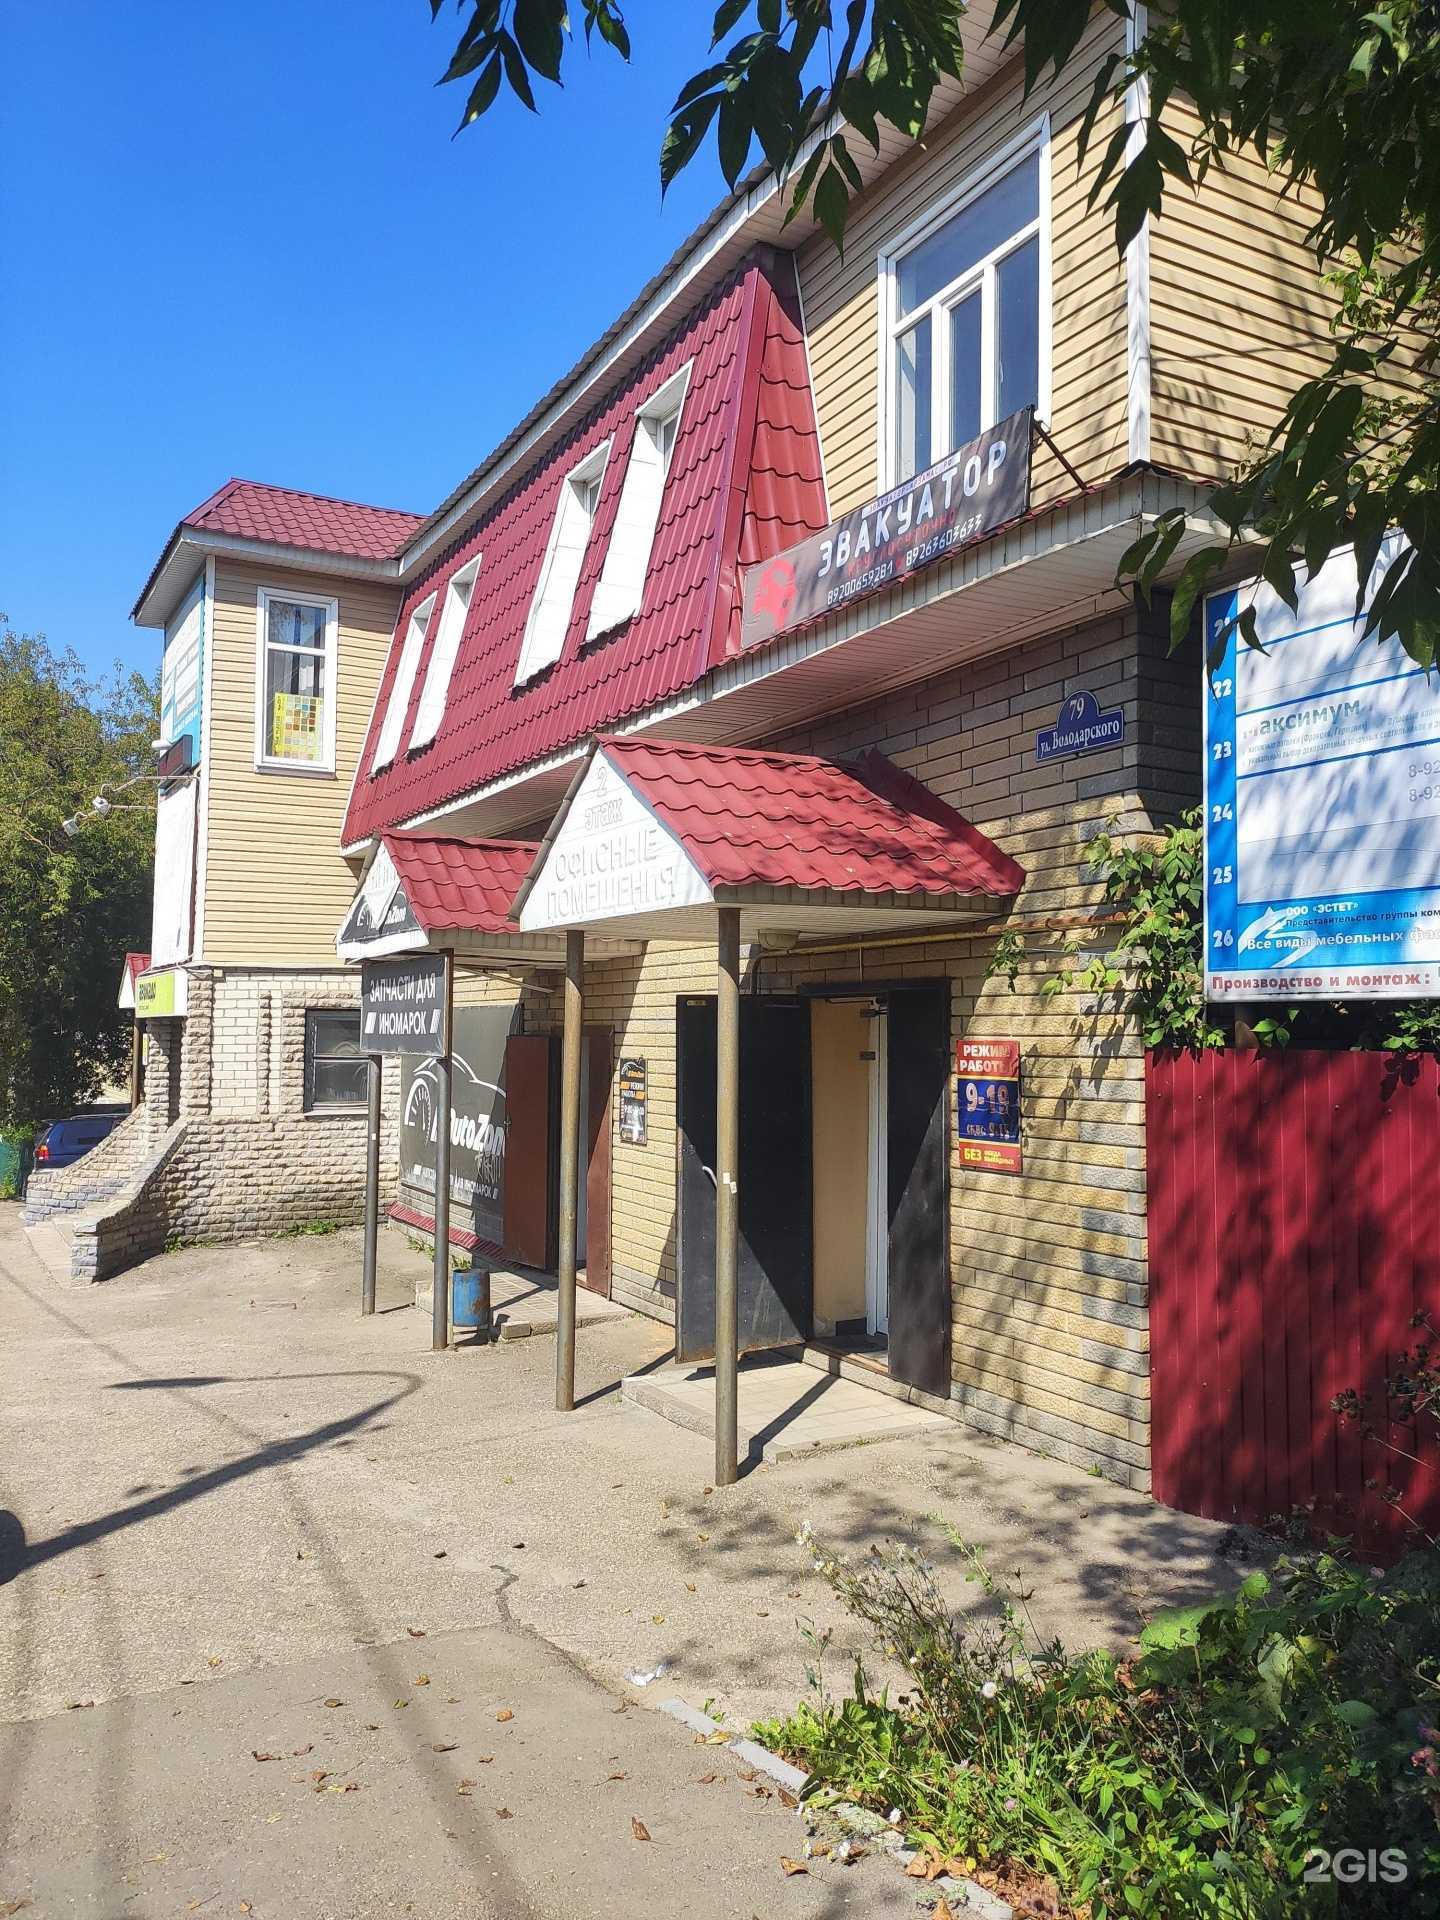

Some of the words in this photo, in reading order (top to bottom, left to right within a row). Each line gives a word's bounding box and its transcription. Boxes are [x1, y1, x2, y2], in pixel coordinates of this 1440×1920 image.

[818, 441, 1007, 577] ЭВАКУАТОР
[1213, 679, 1232, 698] 22
[1069, 697, 1085, 720] 79
[1052, 719, 1120, 750] Володарского
[1213, 741, 1232, 760] 23
[1212, 803, 1232, 822] 24
[1213, 866, 1233, 885] 25
[547, 867, 676, 920] ПОМЕЩЕНИЯ
[1286, 914, 1378, 928] Представительство
[1381, 911, 1417, 922] группы
[1213, 930, 1233, 948] 26
[1247, 938, 1271, 950] Все
[1275, 937, 1312, 950] виды
[1315, 931, 1404, 946] мебельных
[370, 975, 415, 1003] ЗАПЧАСТИ
[416, 972, 435, 1005] ДЛЯ
[1212, 973, 1322, 992] Производство
[1329, 976, 1340, 987] и
[1346, 973, 1430, 986] монтаж:
[379, 1011, 427, 1035] ИНОМАРОК
[963, 1045, 1010, 1057] РЕЖИМ
[964, 1148, 981, 1161] БЕЗ
